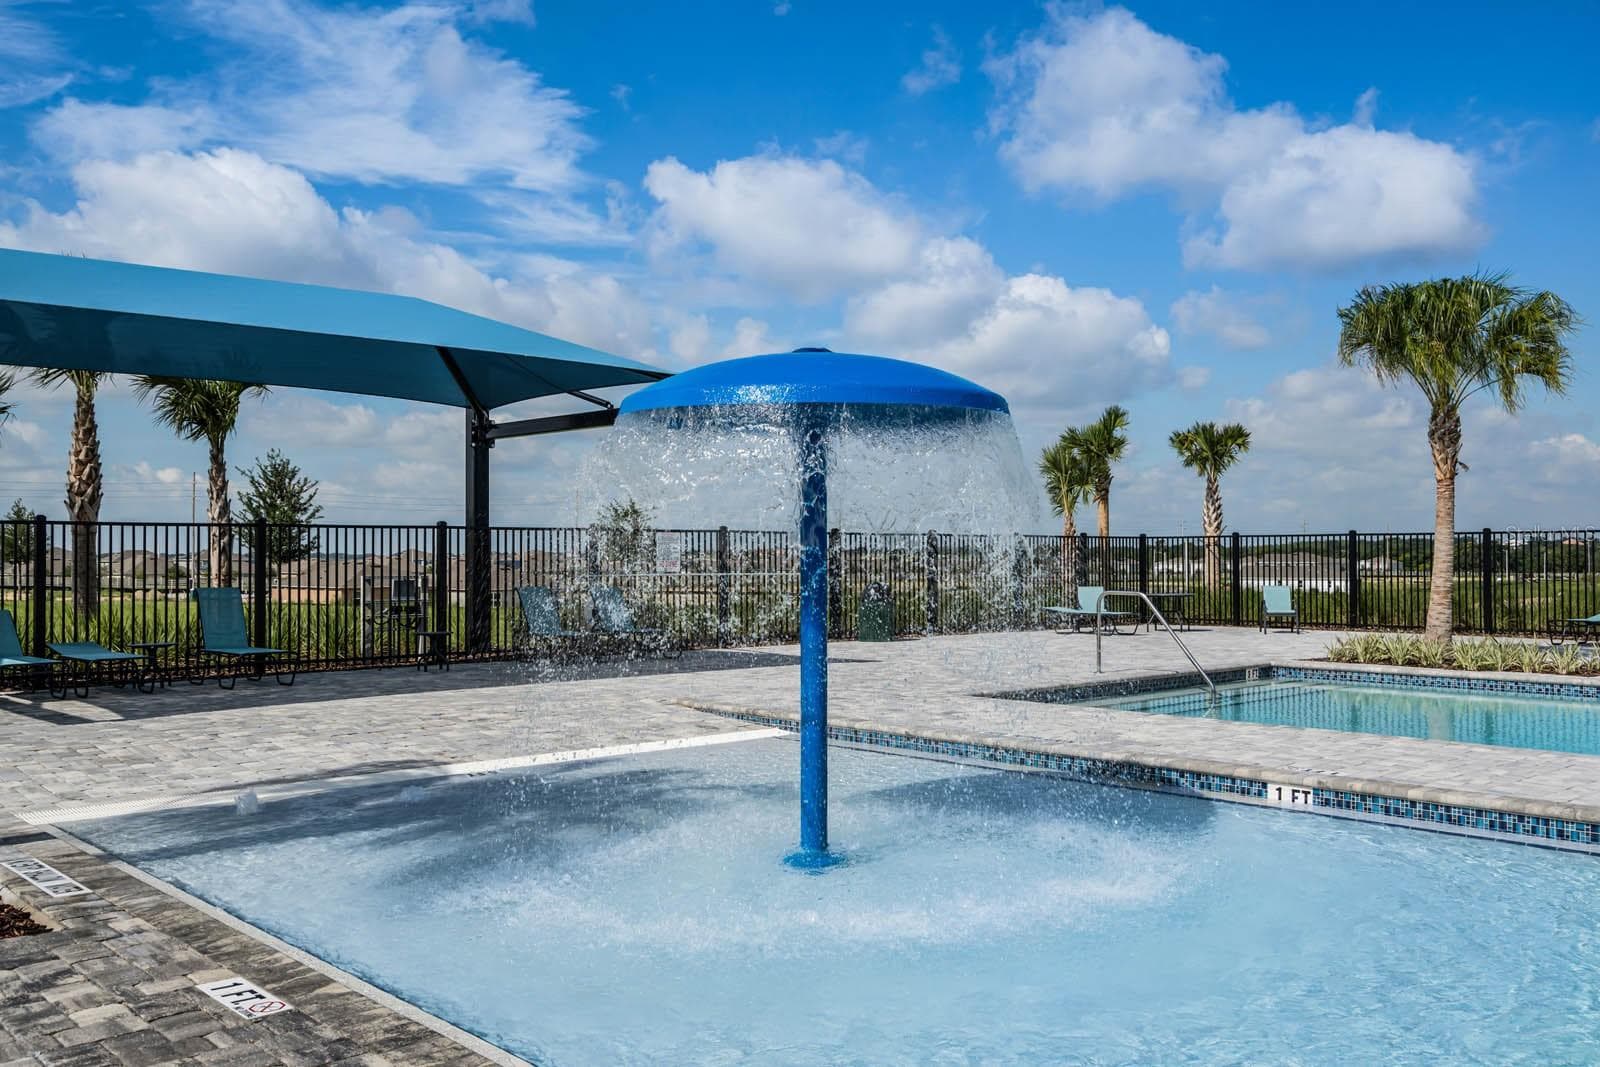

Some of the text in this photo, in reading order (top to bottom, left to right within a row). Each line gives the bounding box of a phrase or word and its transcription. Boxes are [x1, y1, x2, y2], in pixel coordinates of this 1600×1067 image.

[1275, 786, 1311, 805] 1 FT
[210, 982, 243, 991] 1
